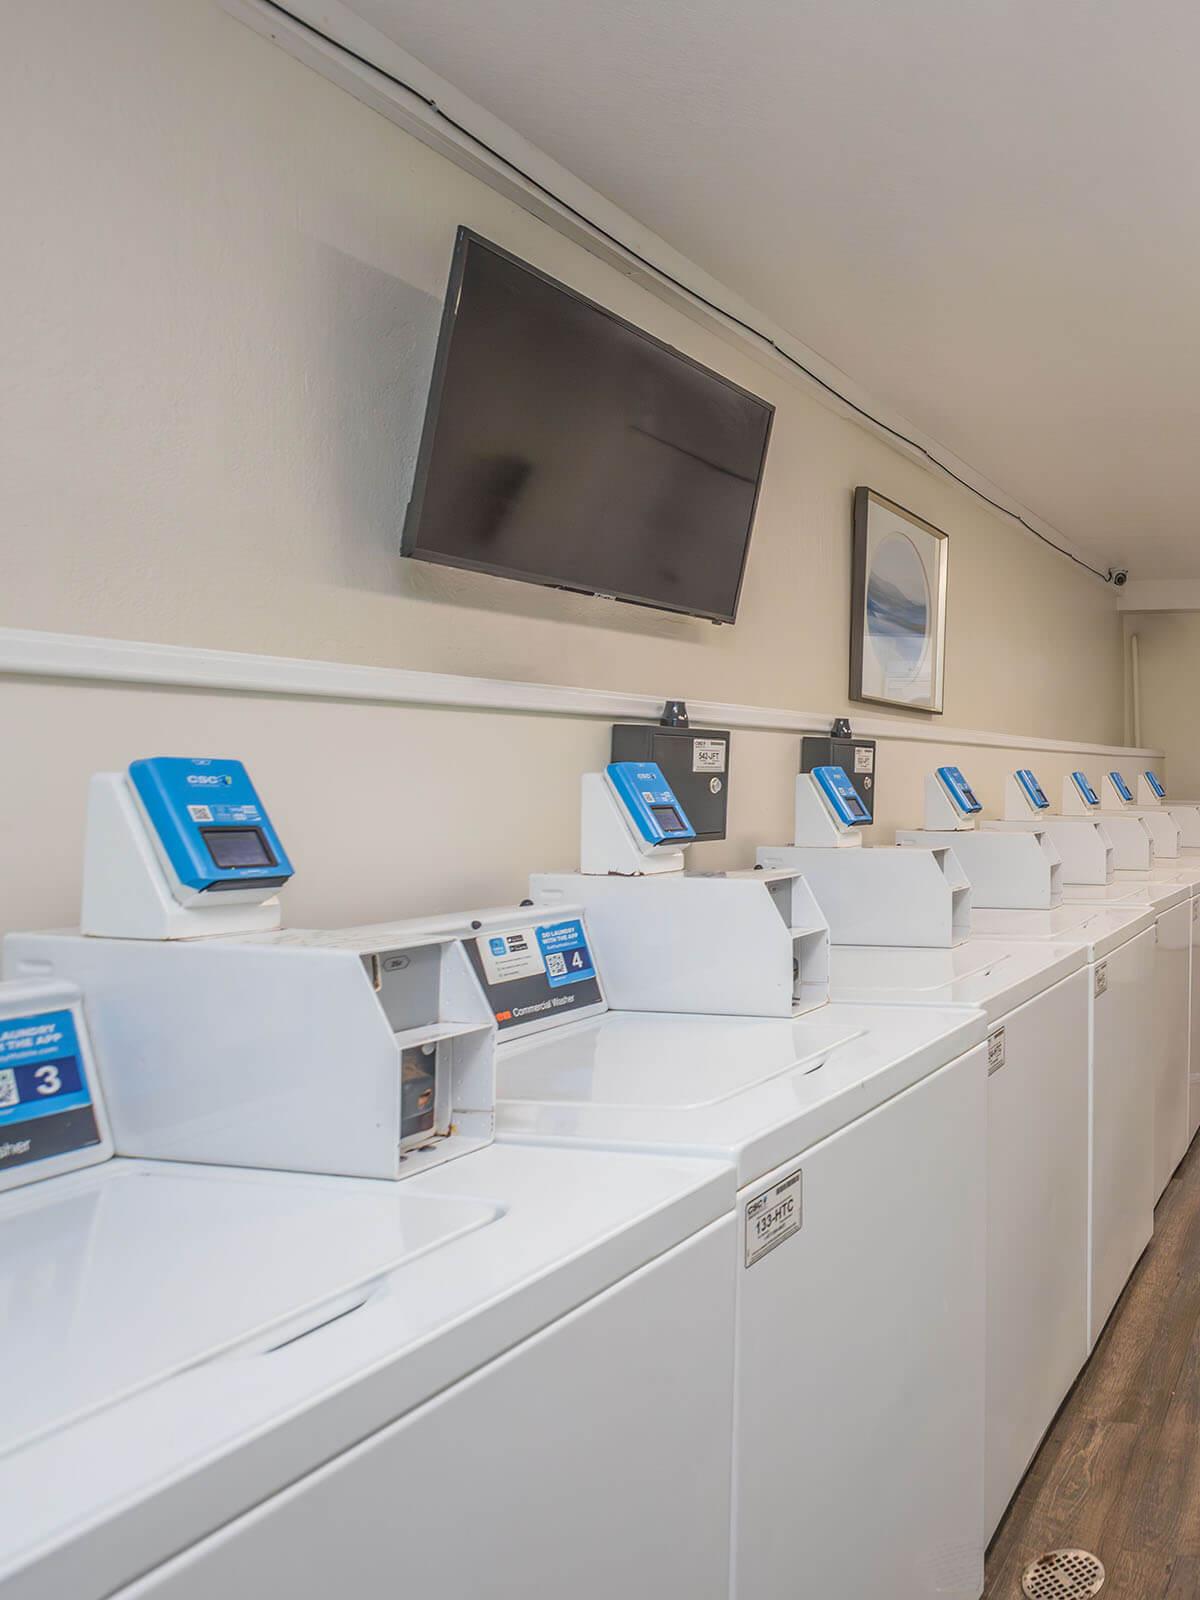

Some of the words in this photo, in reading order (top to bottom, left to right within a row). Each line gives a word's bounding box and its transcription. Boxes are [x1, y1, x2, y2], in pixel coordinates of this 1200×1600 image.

[187, 775, 218, 784] CSC
[572, 951, 583, 968] 4
[512, 999, 552, 1017] Commercial
[552, 994, 575, 1008] Washer
[0, 1024, 56, 1041] AUNDRY
[5, 1037, 34, 1050] THE
[35, 1032, 63, 1046] APP
[34, 1065, 62, 1096] 3
[756, 1199, 794, 1234] 133-HTC
